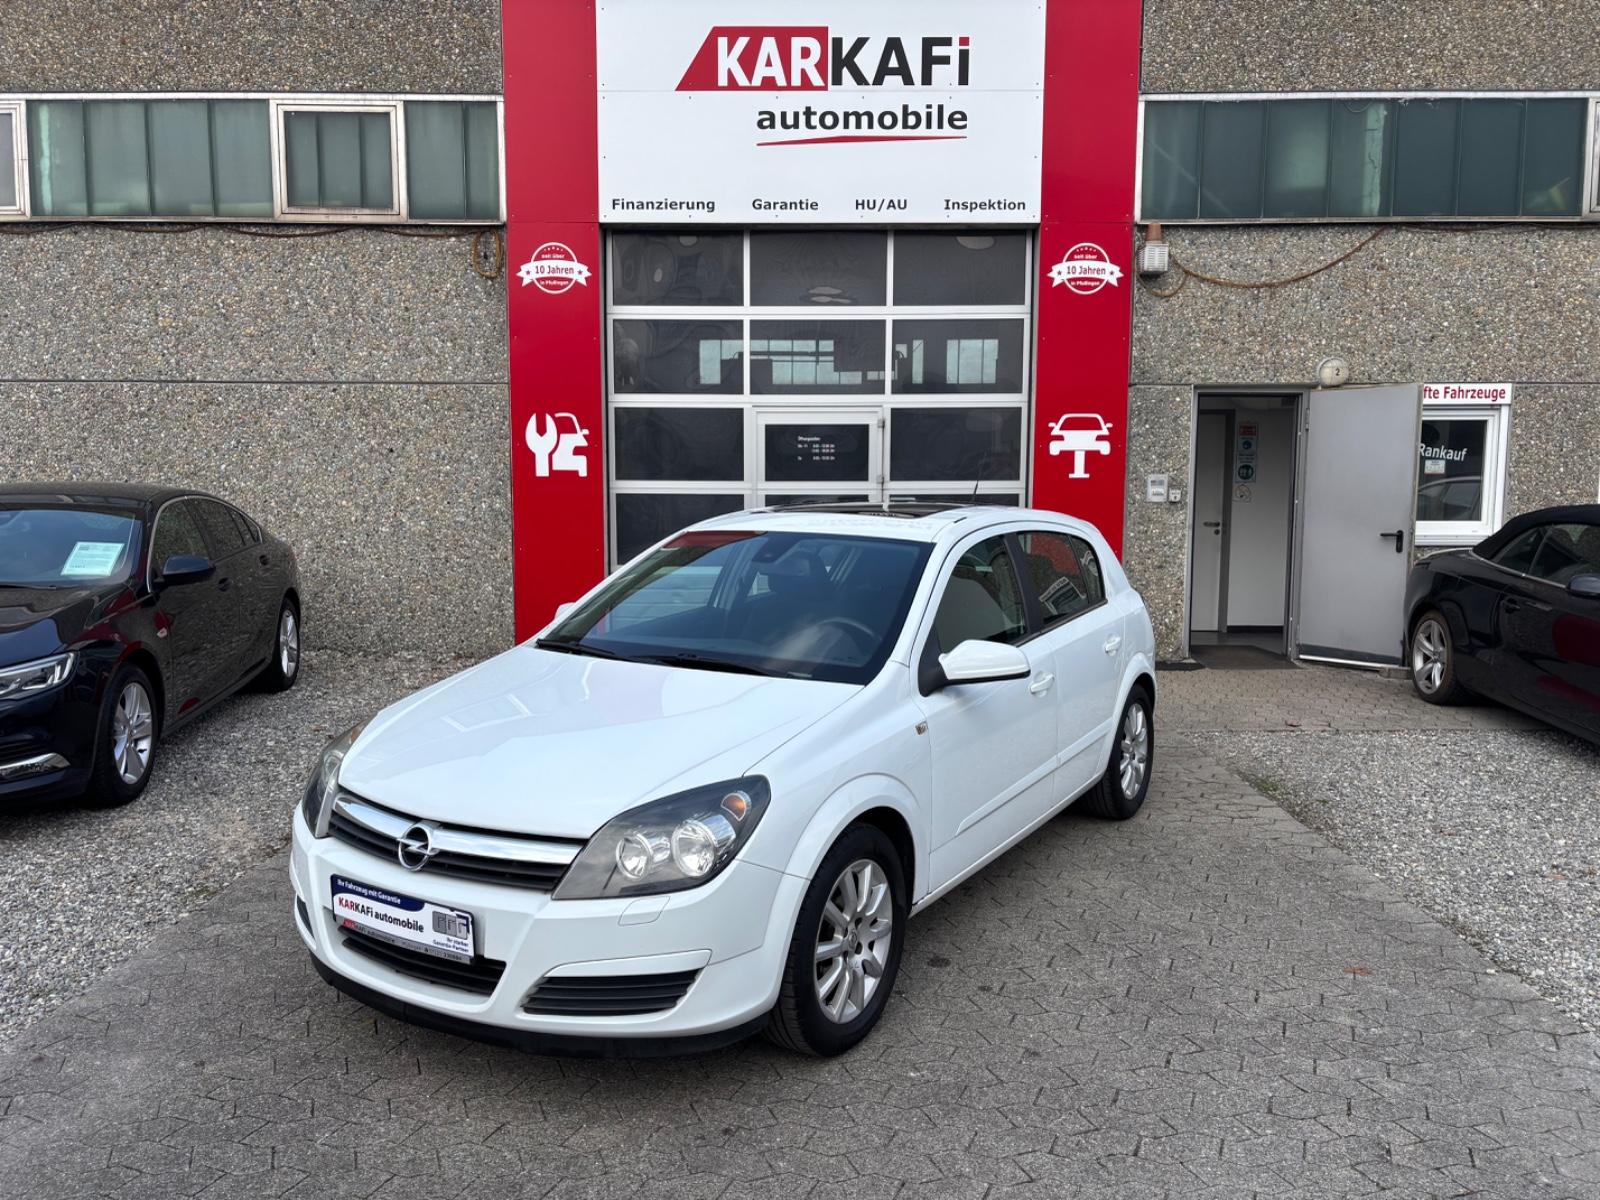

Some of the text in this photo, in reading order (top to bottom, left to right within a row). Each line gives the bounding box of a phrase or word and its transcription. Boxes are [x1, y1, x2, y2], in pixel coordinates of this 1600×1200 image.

[716, 36, 970, 88] KARKAFi
[756, 104, 968, 131] automobile
[611, 198, 716, 213] Finanzierung
[752, 198, 819, 211] Garantie
[855, 198, 908, 212] HU/AU
[944, 198, 1027, 213] Inspektion
[535, 265, 575, 275] 10 Jahren
[1066, 266, 1106, 276] 10 Jahren
[1443, 386, 1506, 402] Fahrzeuge
[344, 880, 368, 897] Fahrzeug
[378, 891, 401, 905] Garantie
[338, 896, 374, 918] KARKAFi
[374, 911, 424, 933] automobile
